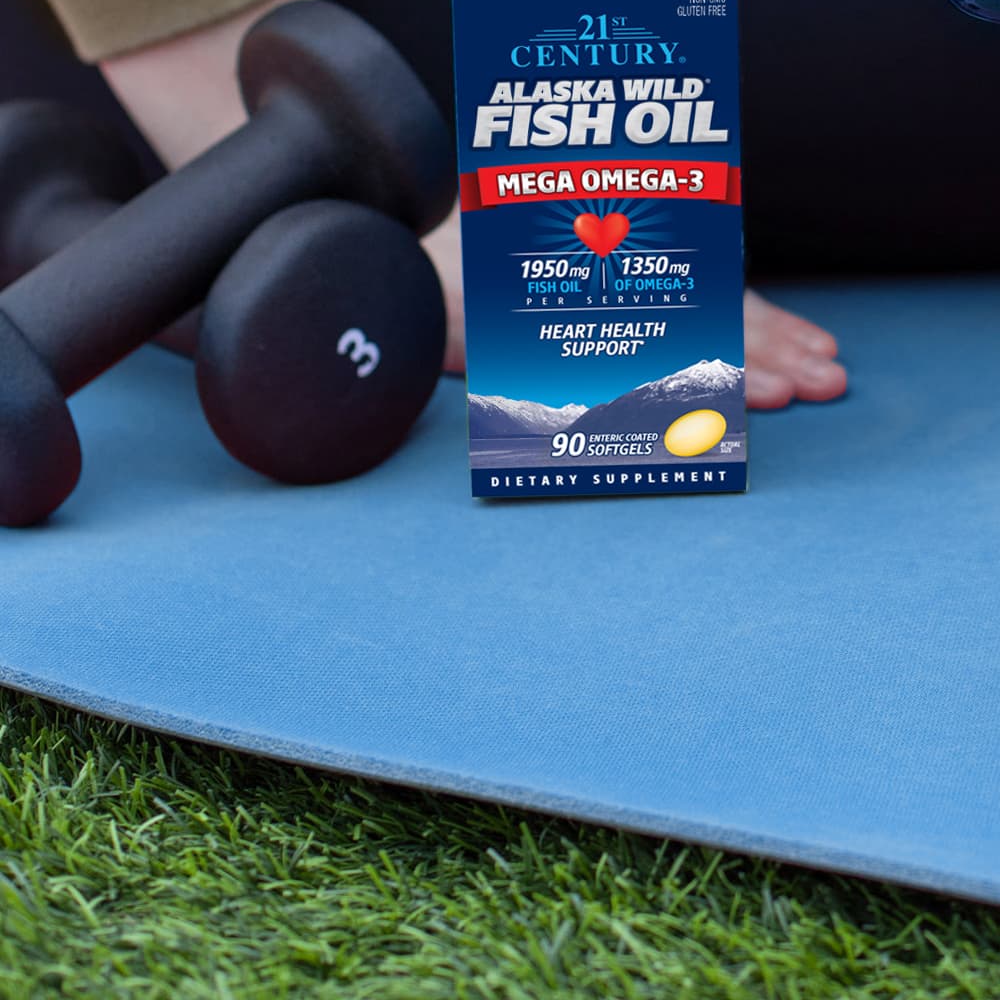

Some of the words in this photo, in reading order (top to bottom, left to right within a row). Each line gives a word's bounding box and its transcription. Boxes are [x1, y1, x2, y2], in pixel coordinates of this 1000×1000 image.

[677, 5, 706, 17] GLUTEN
[708, 4, 727, 16] FREE
[489, 79, 615, 104] ALASKA
[622, 77, 704, 100] WILD
[473, 103, 616, 148] FISH
[624, 100, 729, 144] OIL
[497, 171, 576, 197] MEGA
[581, 168, 705, 193] OMEGA-3
[528, 280, 557, 294] FISH
[560, 280, 582, 293] OIL
[615, 278, 632, 291] OF
[635, 277, 695, 291] OMEGA-3
[526, 296, 565, 306] PER
[587, 294, 688, 305] SERVING
[539, 323, 597, 340] HEART
[600, 321, 667, 338] HEALTH
[336, 327, 382, 379] 3
[551, 432, 586, 457] 90
[589, 433, 624, 443] ENTERIC
[625, 432, 659, 442] COATED
[587, 442, 653, 457] SOFTGELS
[490, 473, 578, 488] DIETARY
[592, 470, 728, 485] SUPPLEMENT
